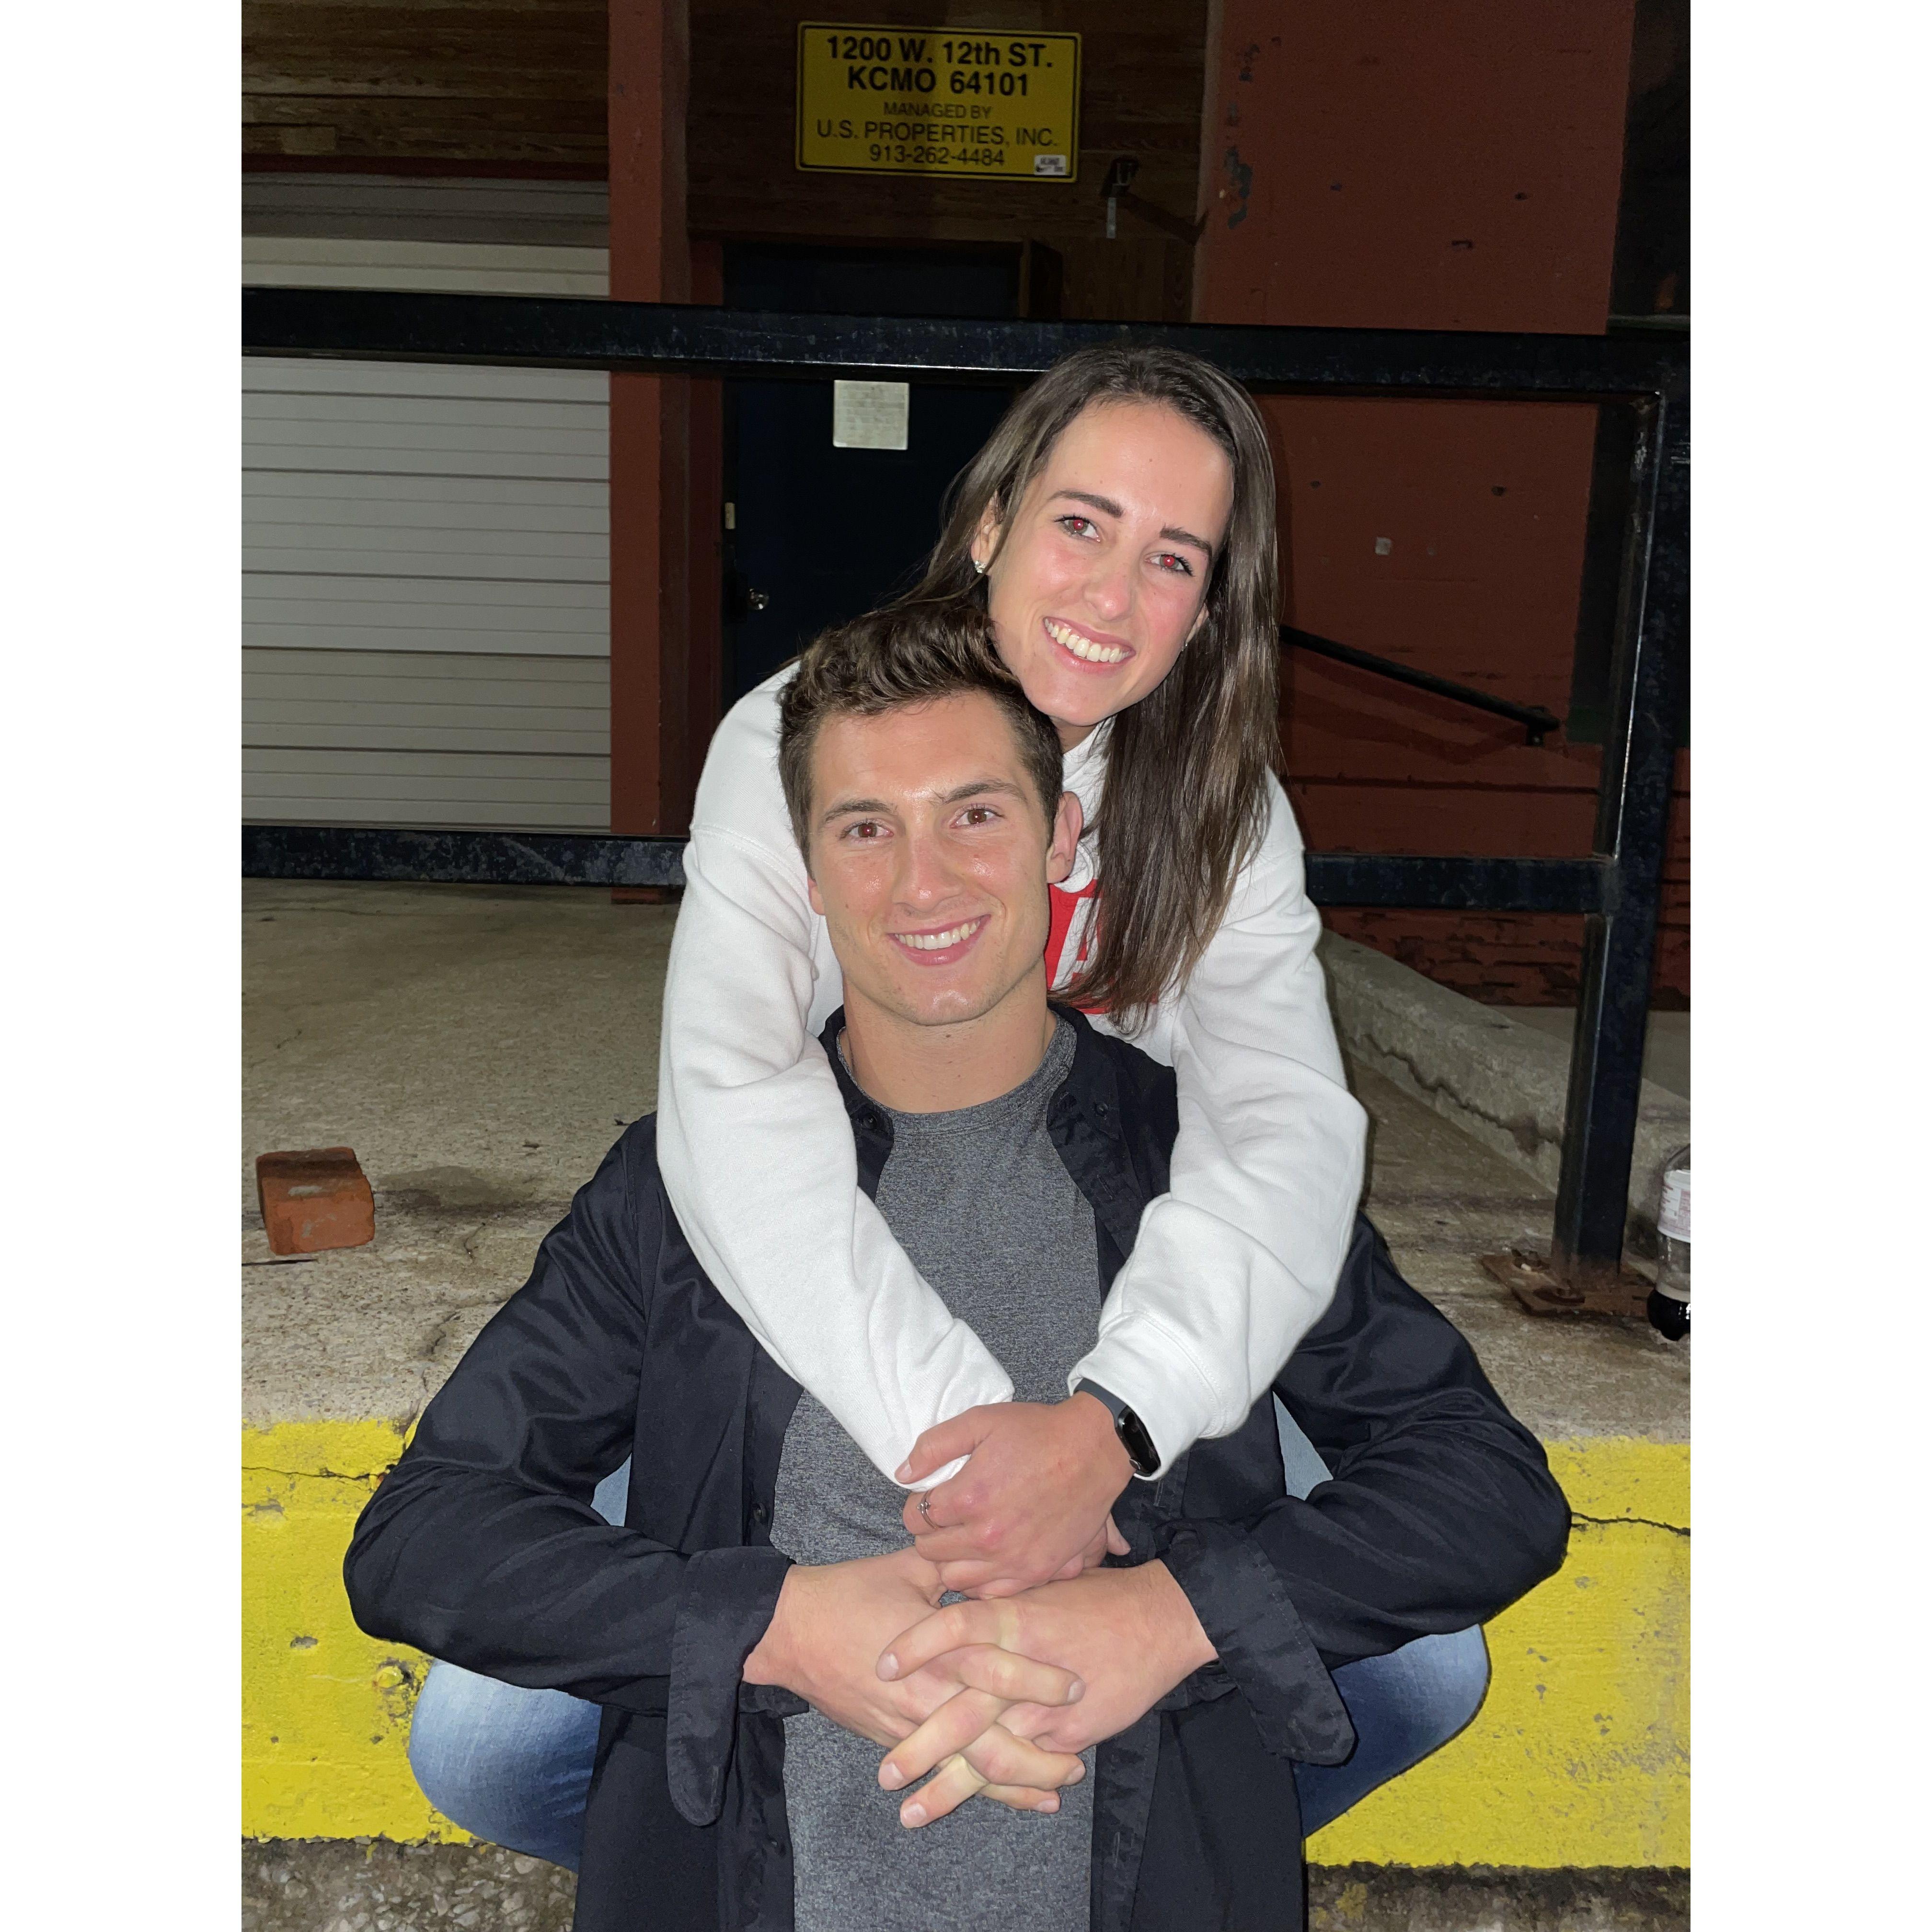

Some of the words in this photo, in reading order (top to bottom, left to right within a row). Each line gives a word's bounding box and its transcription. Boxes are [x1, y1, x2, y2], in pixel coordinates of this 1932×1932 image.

[827, 36, 892, 61] 1200
[898, 38, 933, 64] W.
[943, 41, 1000, 65] 12th
[1009, 43, 1053, 68] ST.
[848, 66, 936, 92] KCMO
[950, 71, 1028, 96] 64101
[884, 102, 966, 118] MANAGED
[971, 105, 992, 119] BY
[817, 119, 859, 138] U.S.
[1016, 127, 1057, 146] INC.
[870, 145, 1004, 165] 913-262-4484
